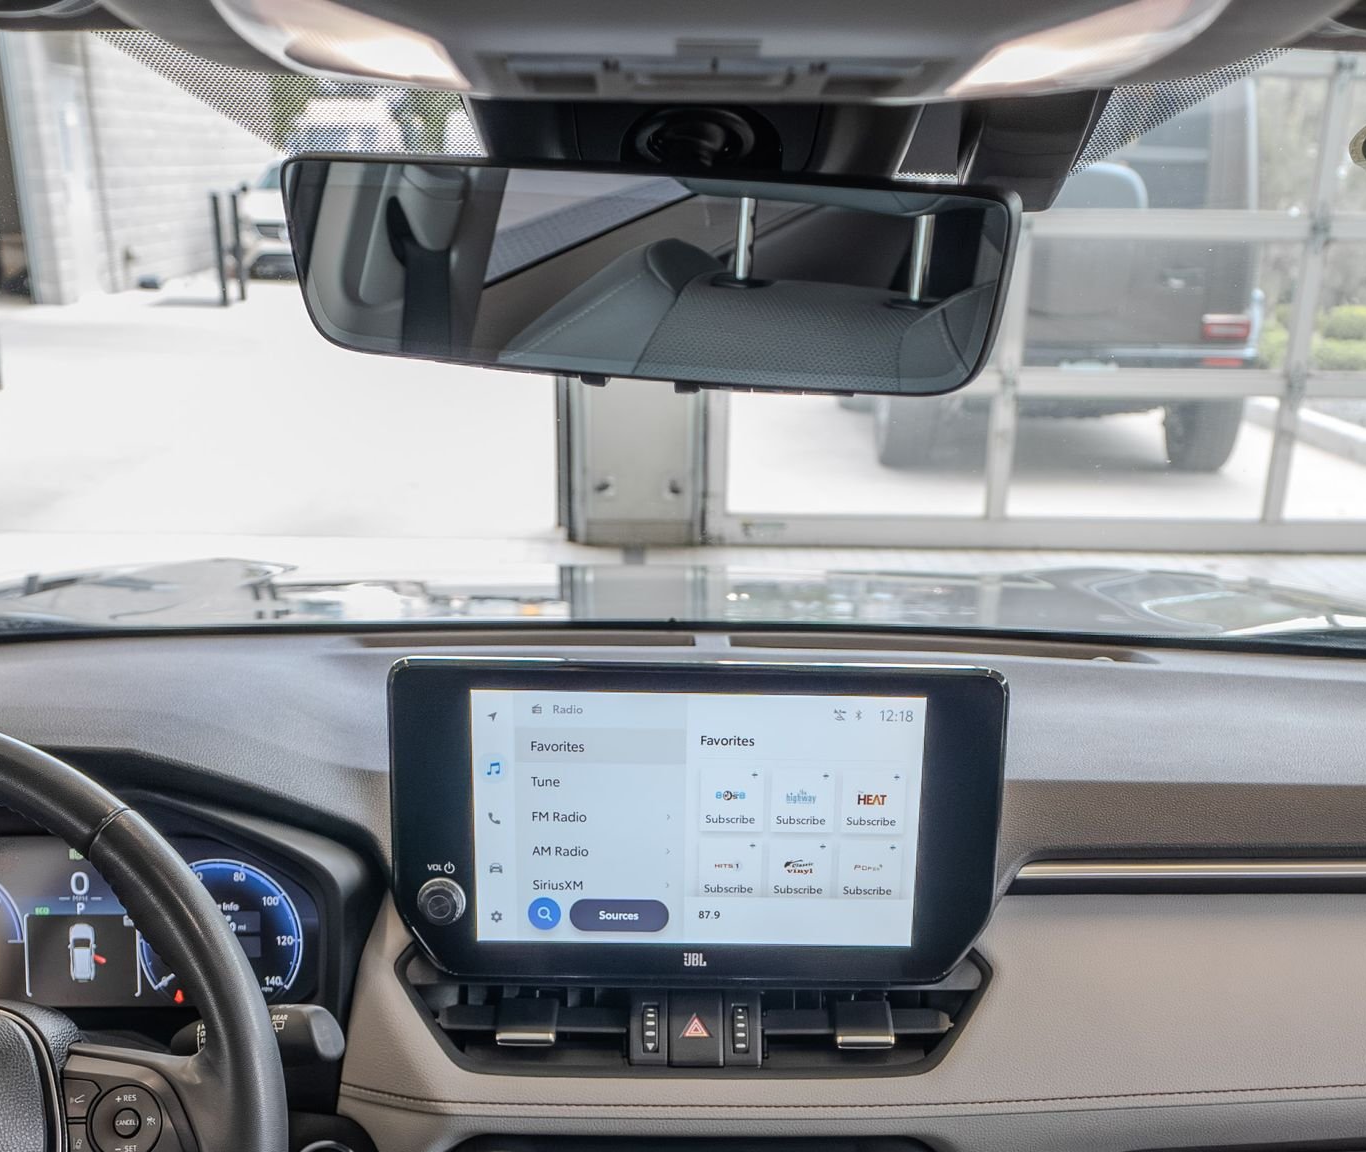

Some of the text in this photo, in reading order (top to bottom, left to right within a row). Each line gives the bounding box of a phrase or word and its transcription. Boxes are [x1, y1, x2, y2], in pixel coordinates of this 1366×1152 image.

[552, 704, 584, 715] Radio
[879, 709, 914, 723] 12:18
[530, 740, 585, 752] Favorites
[700, 735, 755, 747] Favorites
[531, 776, 561, 787] Tune
[786, 793, 816, 804] highway
[857, 794, 887, 806] HEAT
[531, 811, 587, 823] FM Radio
[705, 814, 756, 825] Subscribe
[776, 815, 826, 826] Subscribe
[846, 816, 897, 827] Subscribe
[532, 846, 589, 857] AM Radio
[233, 872, 246, 882] 80
[70, 871, 90, 895] 0
[532, 880, 584, 891] SiriusXM
[704, 884, 753, 894] Subscribe
[773, 885, 823, 895] Subscribe
[842, 886, 892, 896] Subscribe
[262, 896, 279, 906] 100
[35, 906, 50, 915] ECO
[76, 902, 85, 915] P
[222, 903, 239, 912] Info
[598, 910, 639, 921] Sources
[698, 910, 720, 919] 87.9
[276, 936, 293, 946] 120
[683, 952, 707, 967] JBL
[264, 976, 281, 986] 140
[124, 1145, 137, 1152] SET
